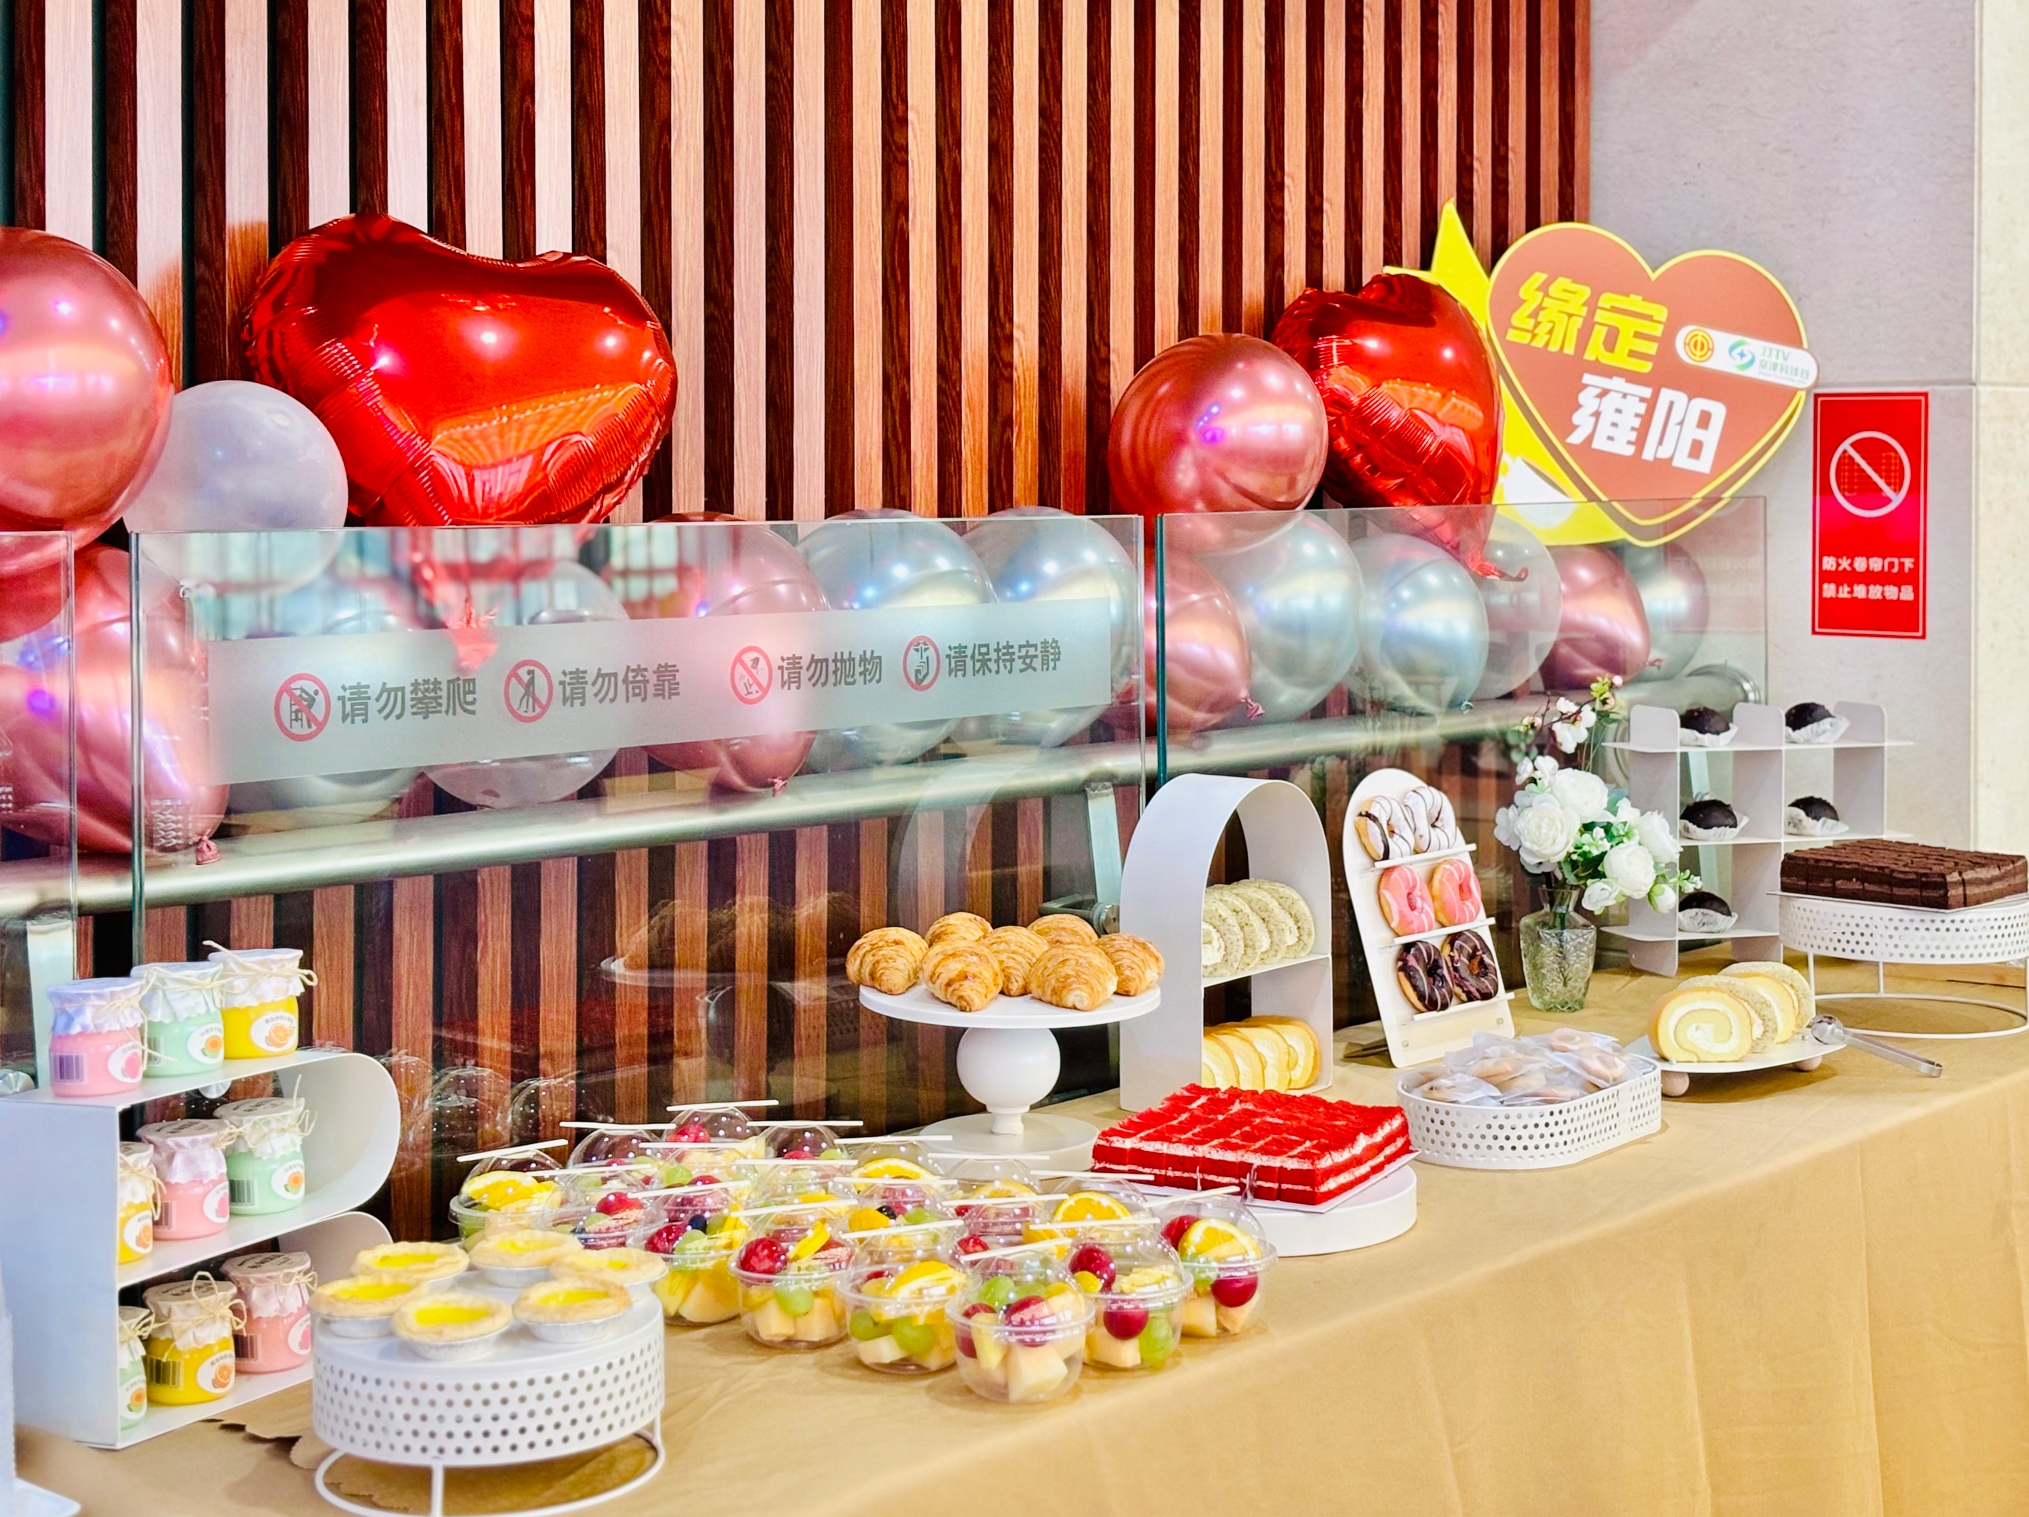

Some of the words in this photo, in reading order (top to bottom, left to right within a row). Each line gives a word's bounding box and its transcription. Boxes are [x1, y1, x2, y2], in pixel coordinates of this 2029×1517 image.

[1505, 271, 1668, 374] 缘定
[1565, 373, 1727, 474] 雍阳
[1821, 555, 1915, 574] 防火卷帘门下
[1821, 582, 1915, 601] 禁止堆放物品
[337, 676, 477, 725] 请勿攀爬
[558, 662, 681, 708] 请勿倚靠
[777, 649, 883, 691] 请勿抛物
[945, 637, 1062, 678] 请保持安静
